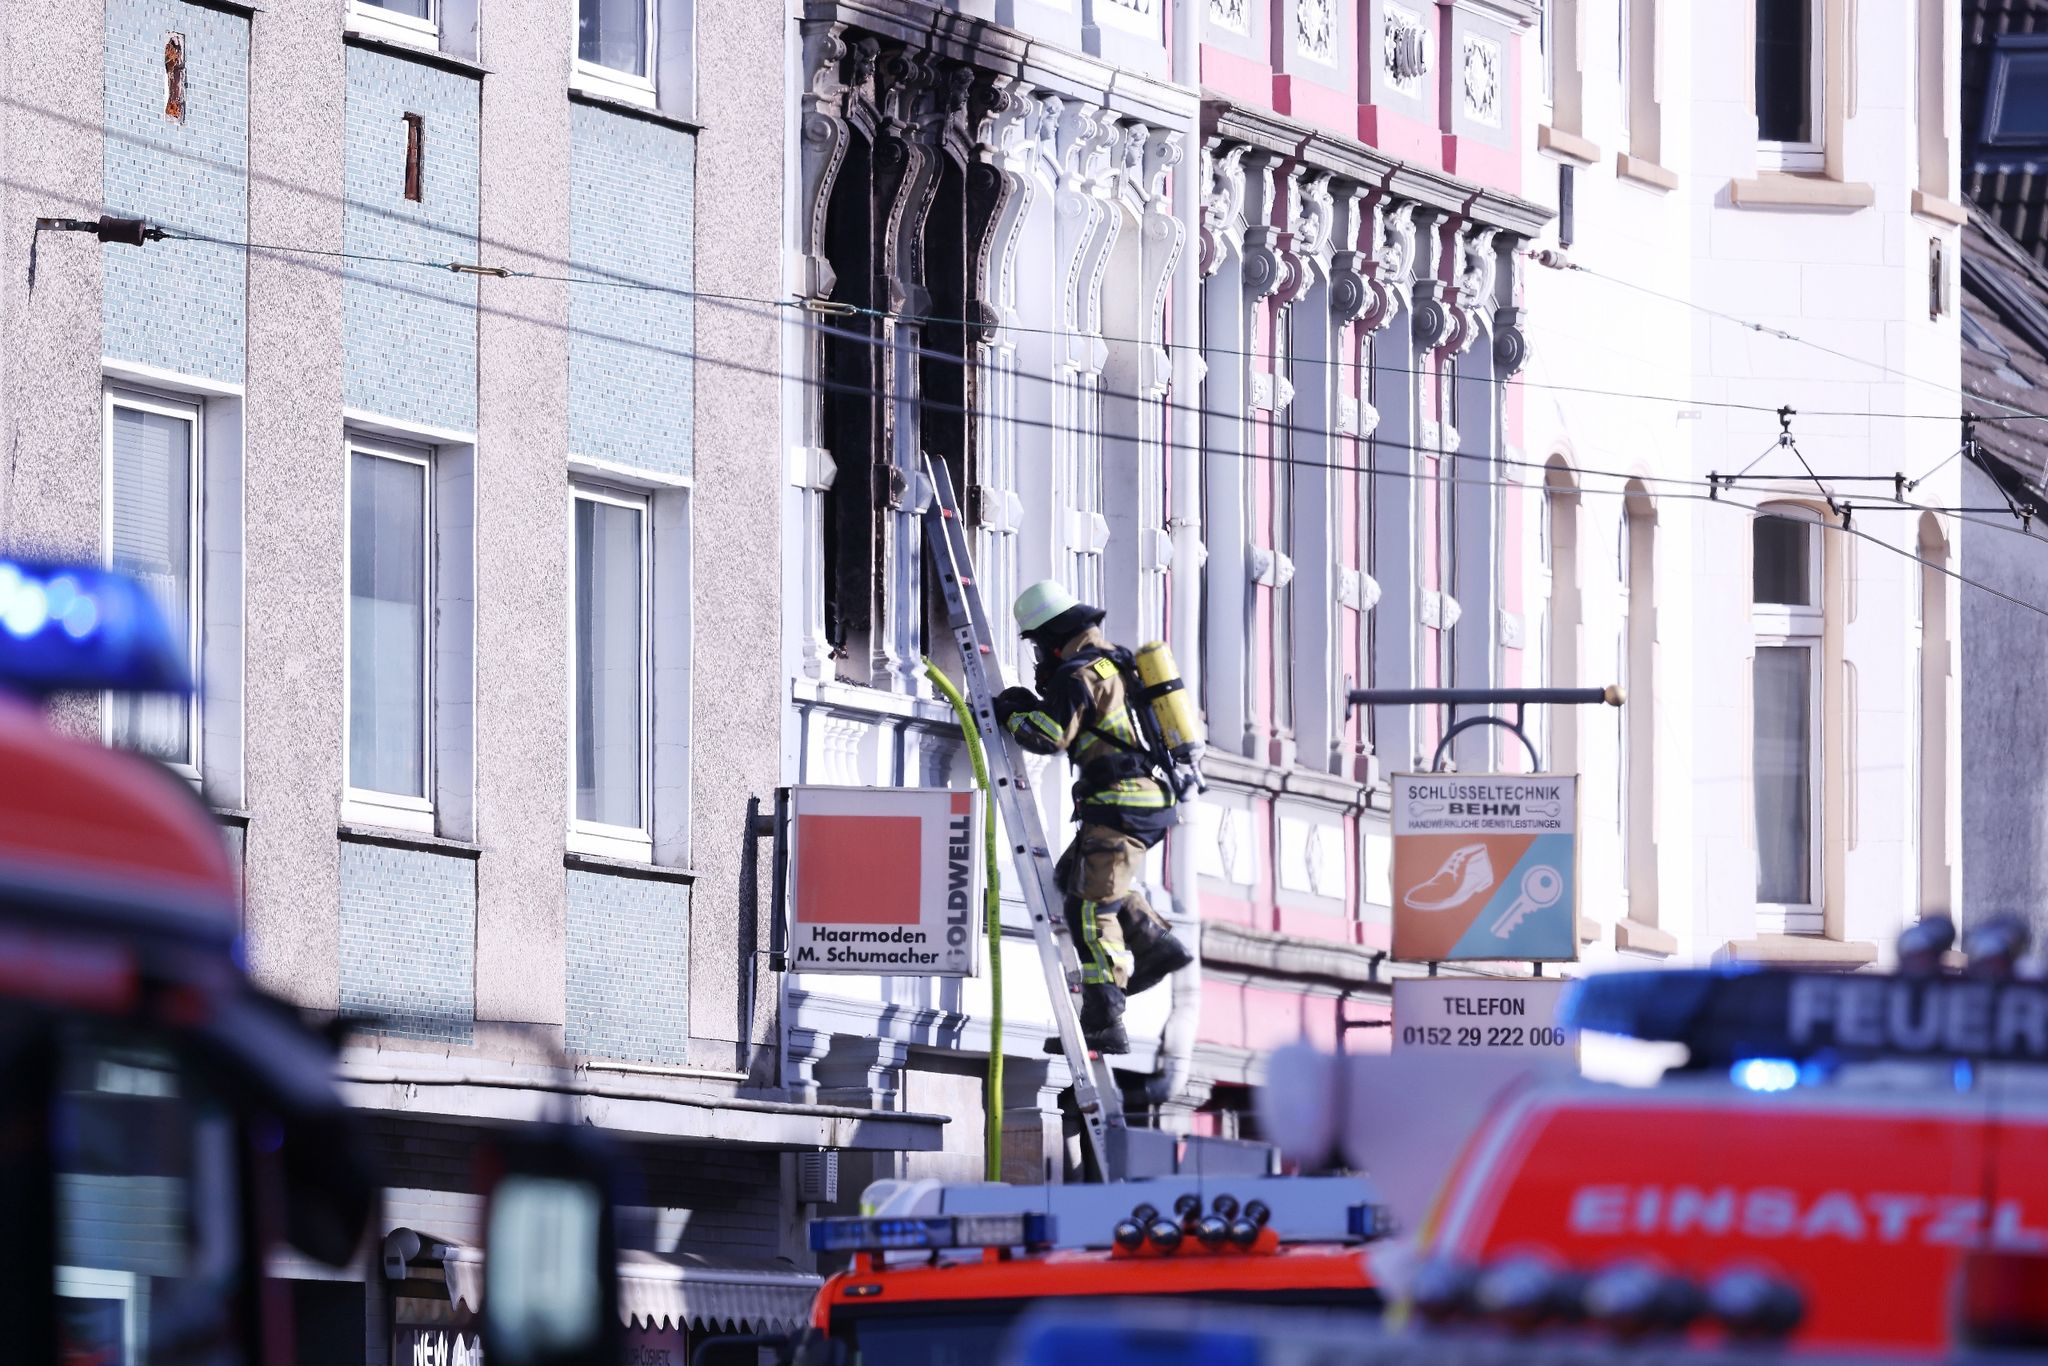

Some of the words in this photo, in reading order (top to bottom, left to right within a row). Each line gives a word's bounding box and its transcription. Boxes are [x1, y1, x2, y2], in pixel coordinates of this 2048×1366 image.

[1408, 782, 1561, 801] SCHLÜSSELTECHNIK
[1449, 802, 1521, 816] BEHM
[1408, 819, 1480, 829] HANDWERKLICHE
[1481, 819, 1561, 829] DIENSTLEISTUNGEN
[812, 926, 927, 943] Haarmoden
[797, 946, 820, 962] M.
[826, 945, 940, 964] Schumacher
[1443, 997, 1525, 1016] TELEFON
[1788, 977, 2048, 1052] FEUER
[1403, 1026, 1451, 1046] 0152
[1457, 1027, 1481, 1046] 29
[1487, 1027, 1524, 1046] 222
[1529, 1027, 1565, 1046] 006
